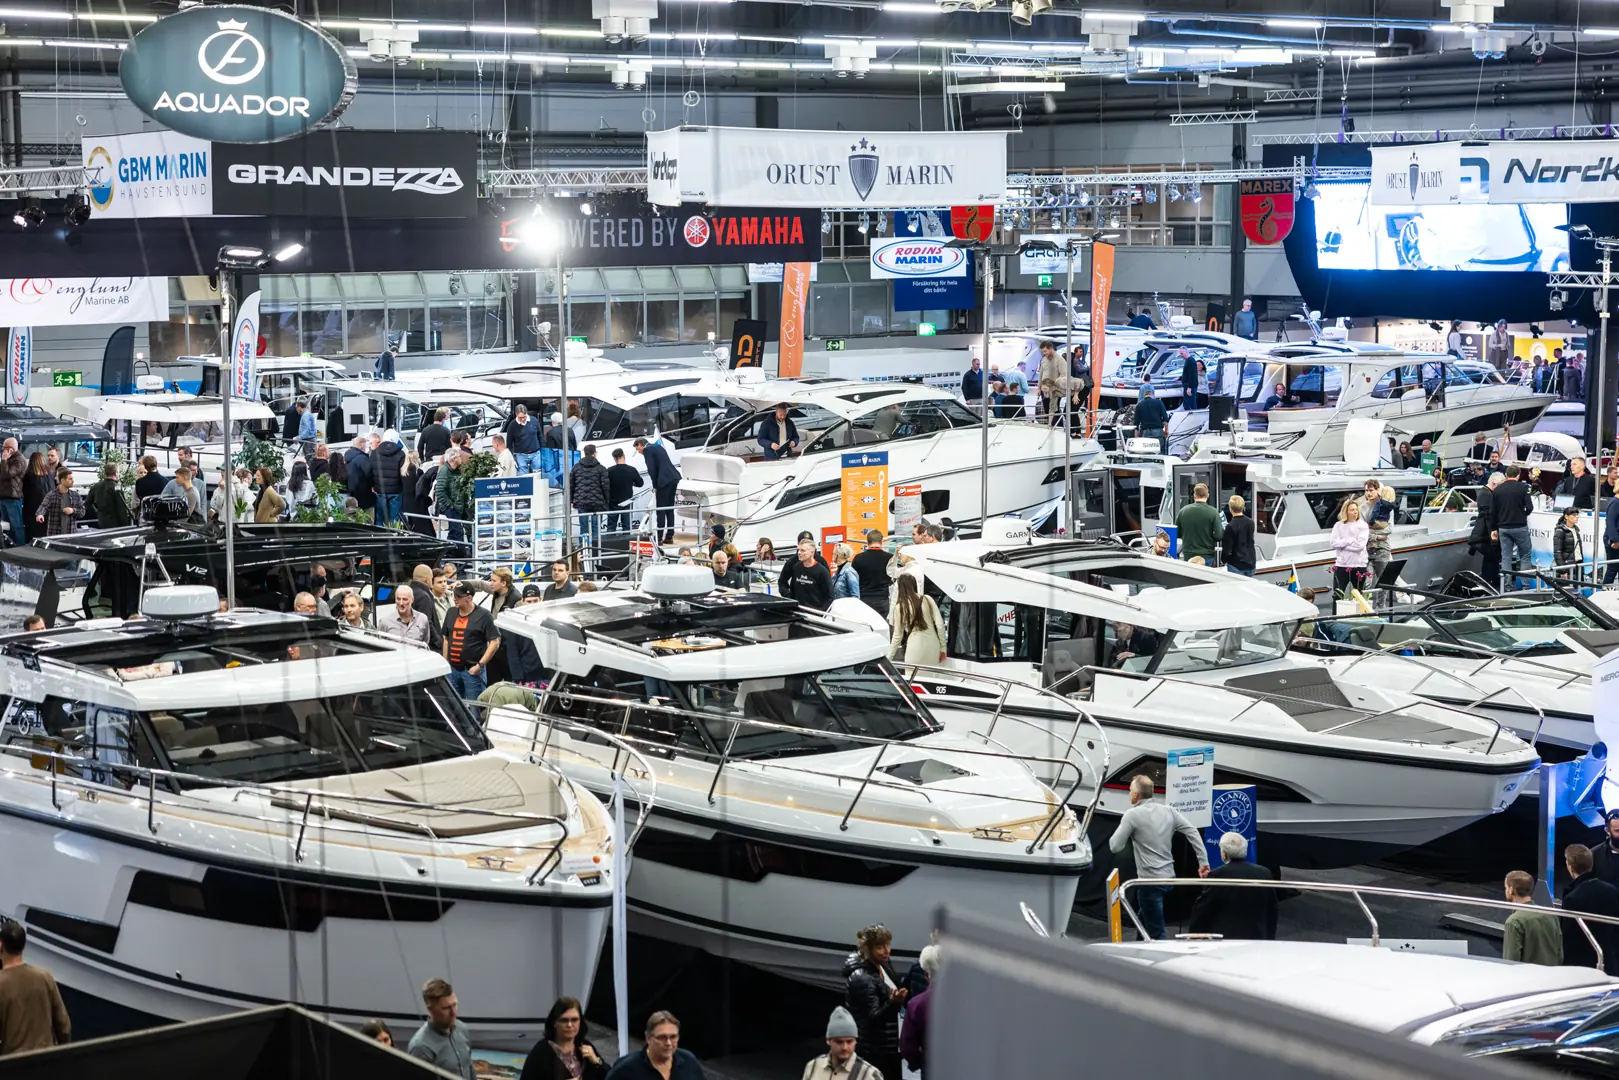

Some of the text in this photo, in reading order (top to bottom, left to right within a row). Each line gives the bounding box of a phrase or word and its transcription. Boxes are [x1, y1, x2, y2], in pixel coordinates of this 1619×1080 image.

[153, 91, 310, 118] AQUADOR
[118, 151, 207, 184] GBM MARIN
[766, 164, 955, 186] ORUST MARIN
[227, 163, 465, 195] GRANDEZZA
[1241, 180, 1292, 194] MAREX
[1385, 170, 1443, 189] ORUST MARIN
[120, 183, 206, 200] HAVSTENSUND
[652, 218, 678, 246] BY
[711, 216, 805, 245] YAMAHA
[895, 246, 944, 256] RODINS
[895, 255, 943, 265] MARIN
[85, 295, 130, 306] Marine AB
[237, 341, 245, 395] RODINS
[243, 343, 251, 395] MARIN
[592, 430, 602, 439] 37
[1529, 528, 1552, 538] RUST
[186, 563, 208, 576] V12
[935, 685, 947, 694] 905
